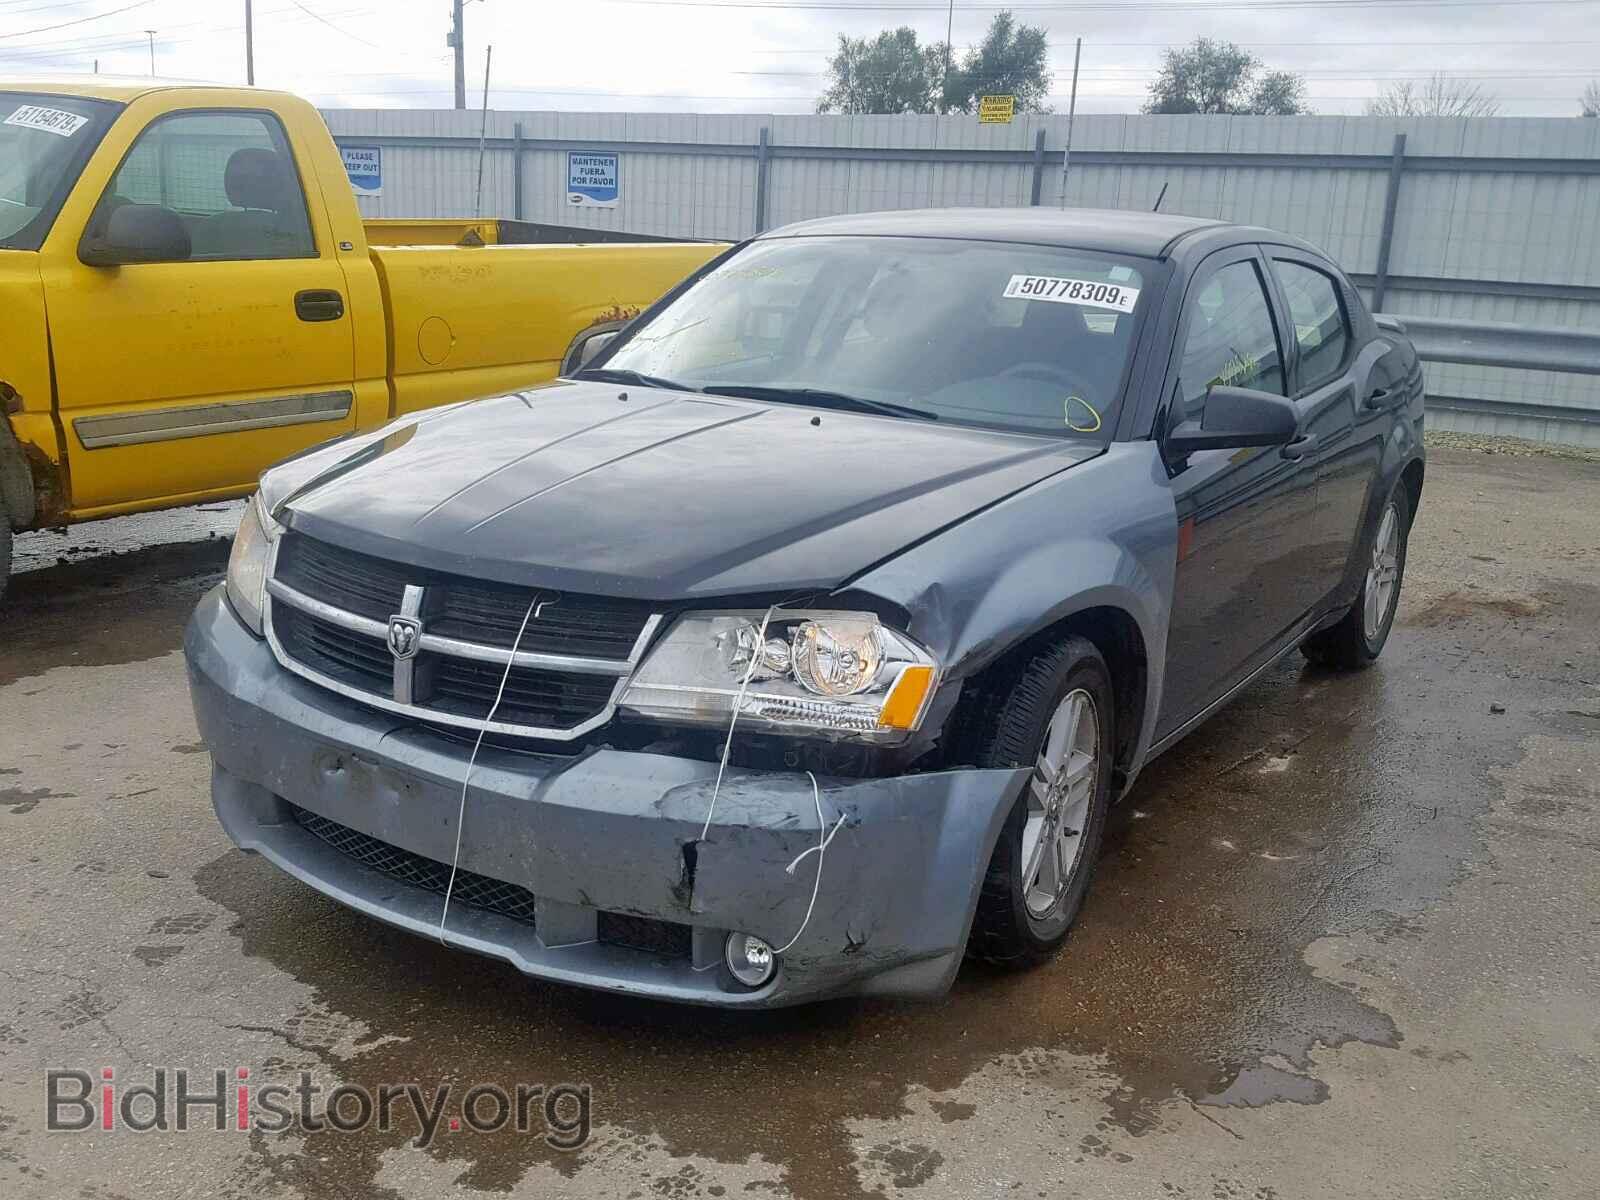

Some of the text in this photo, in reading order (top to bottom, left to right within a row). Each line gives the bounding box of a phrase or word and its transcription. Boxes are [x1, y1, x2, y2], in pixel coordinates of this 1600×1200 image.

[347, 151, 374, 160] PLEASE
[572, 157, 615, 167] MANTENER
[362, 163, 377, 171] OUT
[580, 167, 606, 175] FUERA
[572, 176, 615, 186] POR FAVOR
